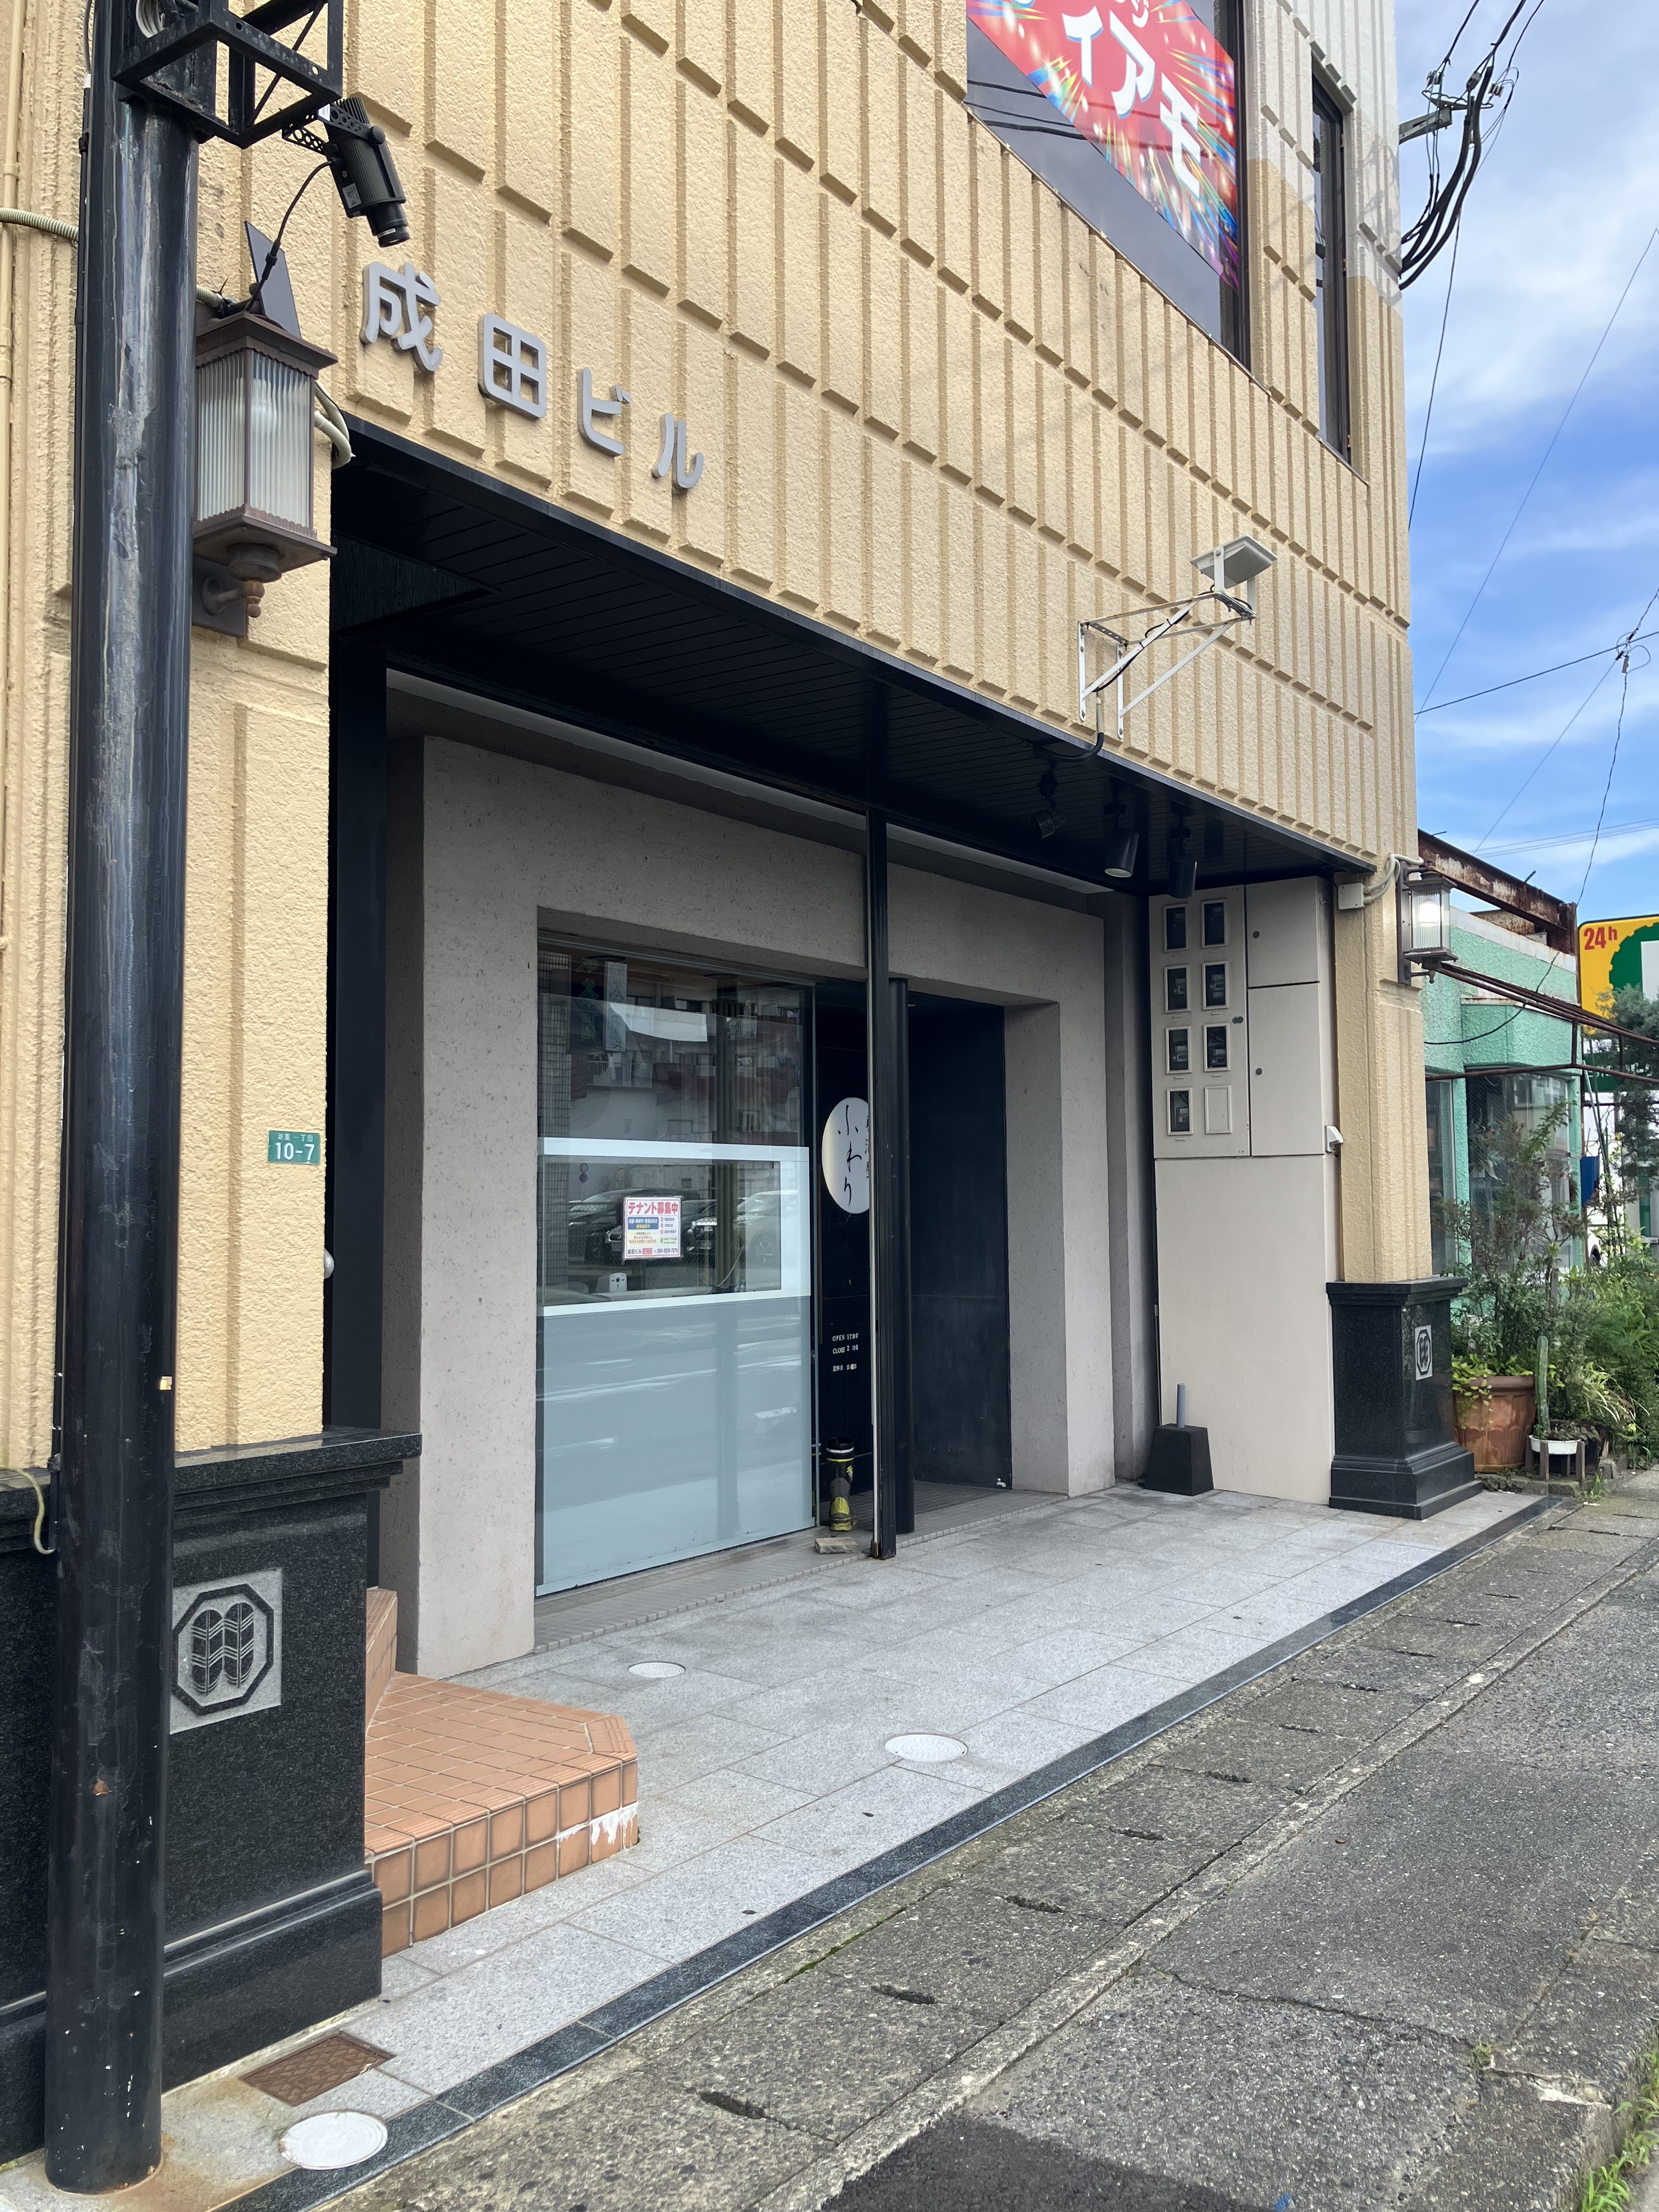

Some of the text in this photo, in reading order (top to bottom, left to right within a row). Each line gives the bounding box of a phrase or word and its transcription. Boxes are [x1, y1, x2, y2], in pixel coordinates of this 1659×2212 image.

[1012, 0, 1201, 200] イアモ
[360, 261, 704, 490] 成田ビル
[1583, 926, 1618, 951] 24h
[276, 1142, 315, 1161] 10-7
[628, 1201, 678, 1215] テナント募集中
